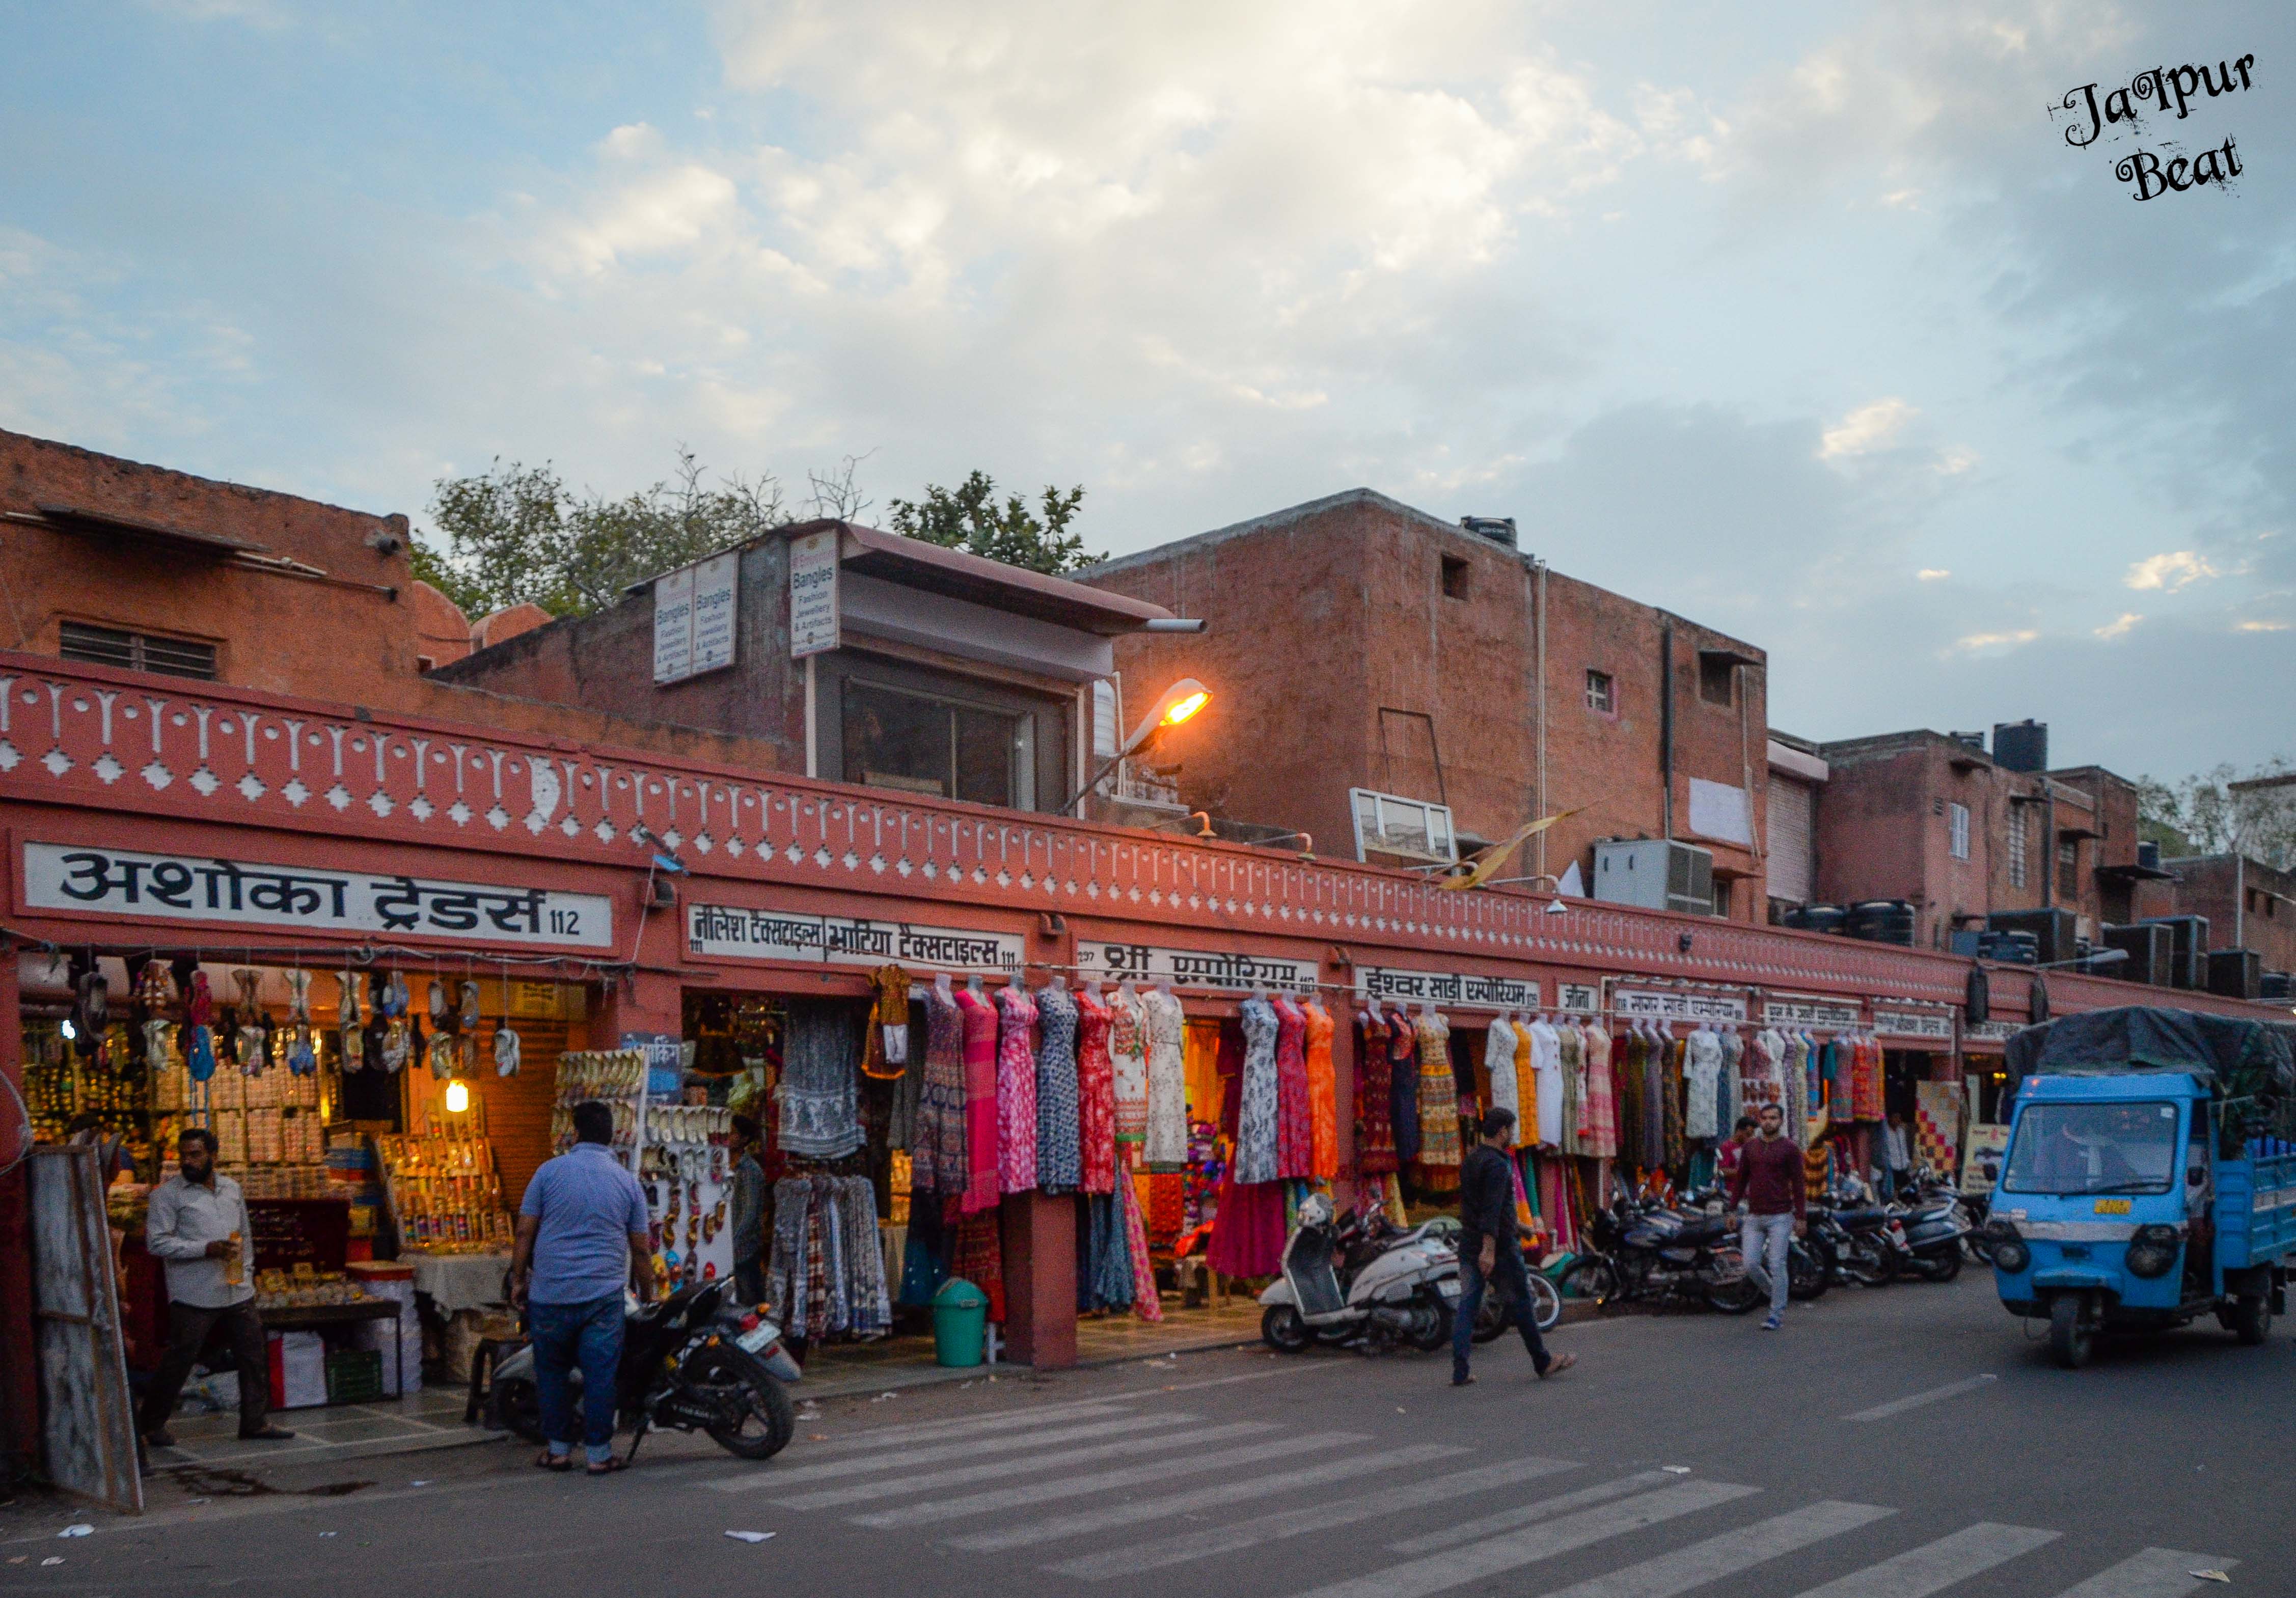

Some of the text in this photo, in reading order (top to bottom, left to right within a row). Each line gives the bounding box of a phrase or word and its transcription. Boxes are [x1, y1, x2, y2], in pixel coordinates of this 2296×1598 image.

[793, 566, 833, 589] Bangles
[697, 589, 731, 610] Bangles
[798, 590, 828, 605] Fashion
[658, 604, 690, 625] Bangles
[796, 603, 830, 619] Jewellery
[61, 852, 546, 934] अशोका ट्रेडर्स
[550, 909, 580, 936] 112
[695, 905, 746, 942] नीलेश
[829, 920, 892, 955] भाटिया
[1002, 951, 1016, 972] 111
[1104, 946, 1153, 981] श्री
[1365, 967, 1425, 999] ईश्वर
[1465, 977, 1526, 1005] एम्पोरियम
